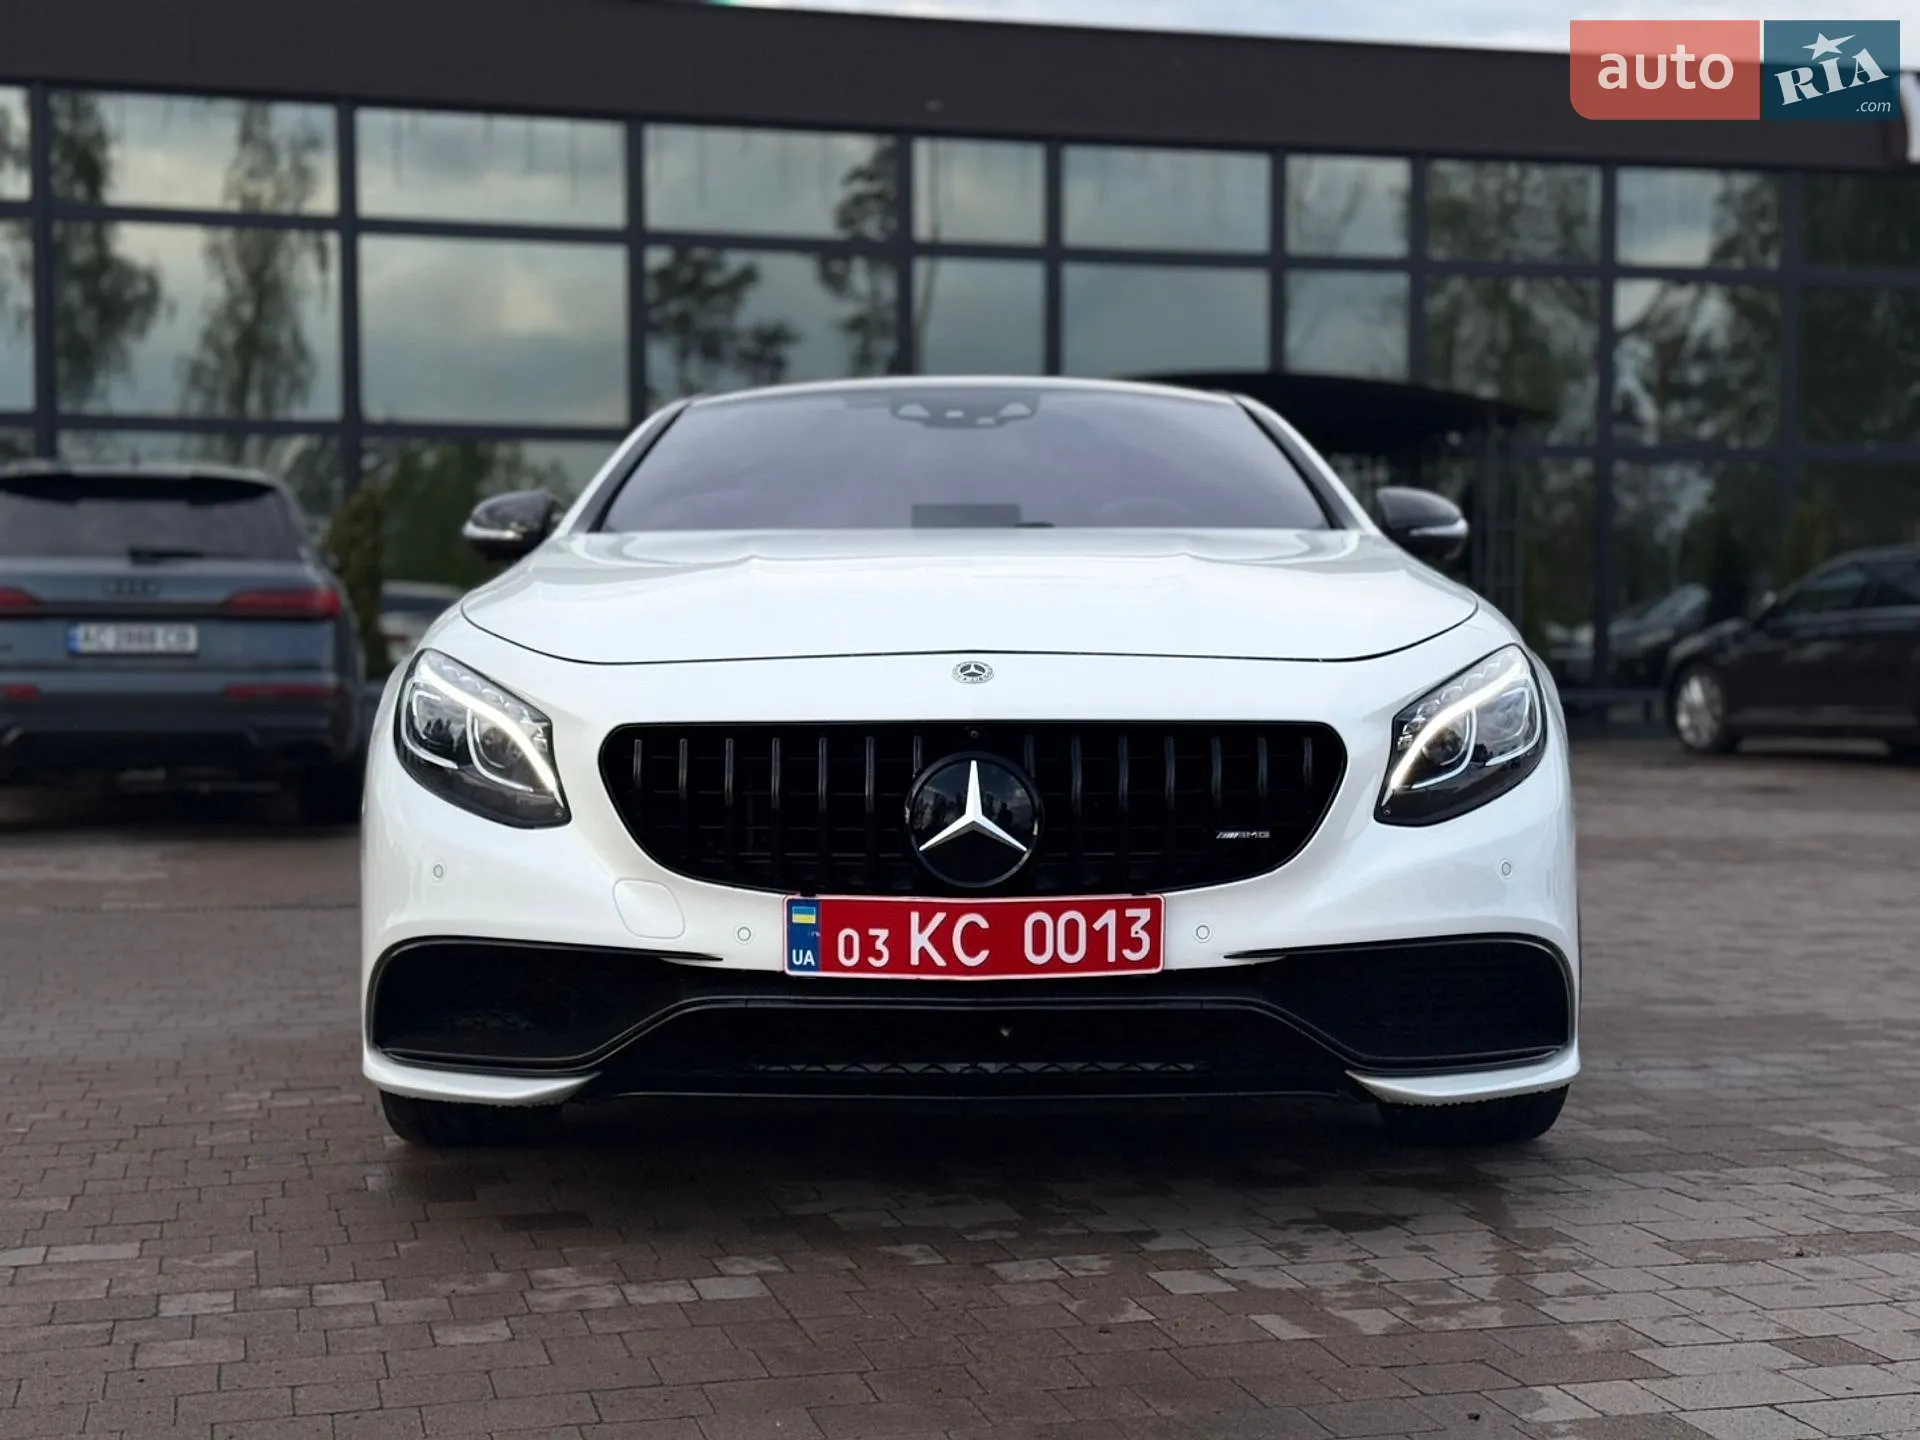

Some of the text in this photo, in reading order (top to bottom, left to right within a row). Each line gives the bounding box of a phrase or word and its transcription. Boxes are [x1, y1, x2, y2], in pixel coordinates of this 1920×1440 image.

[837, 908, 1152, 967] 03 KC 0013
[792, 949, 815, 966] UA
